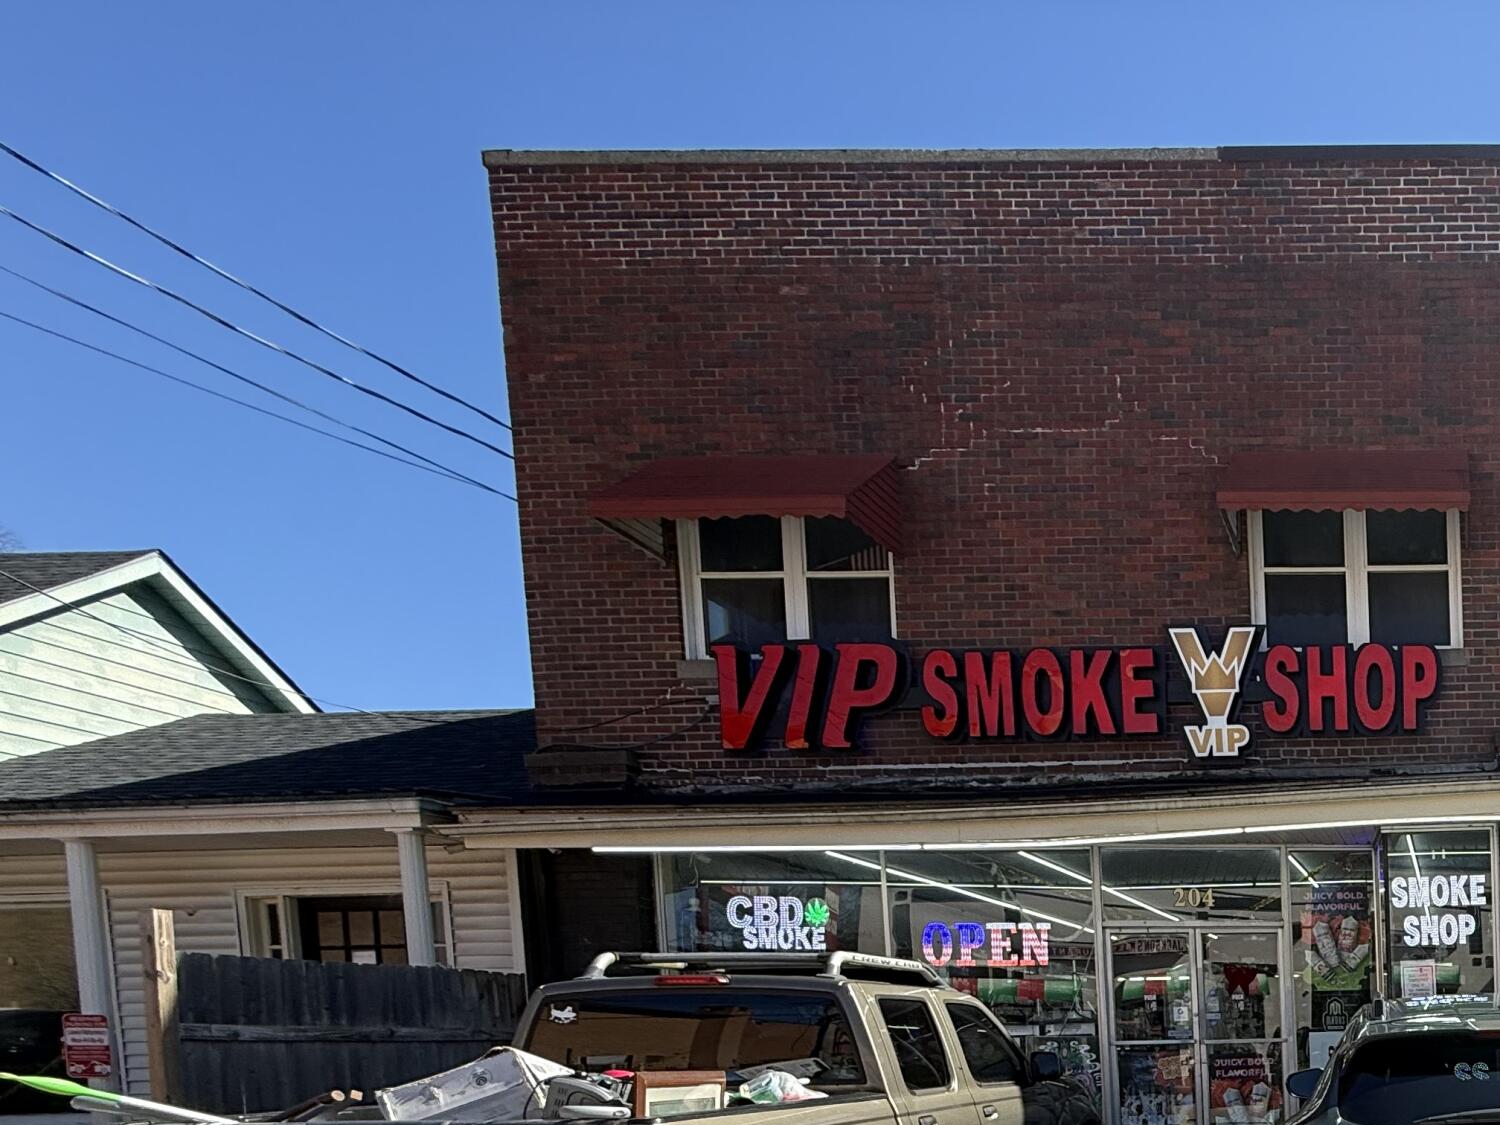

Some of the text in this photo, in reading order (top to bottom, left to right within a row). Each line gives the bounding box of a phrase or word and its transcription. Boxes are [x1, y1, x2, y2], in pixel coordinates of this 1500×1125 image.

[711, 642, 1159, 750] VIP SMOKE
[1263, 643, 1438, 732] SHOP
[1184, 724, 1250, 757] VIP
[1173, 888, 1216, 908] 204
[1336, 890, 1366, 900] BOLD.
[1391, 874, 1487, 908] SMOKE
[726, 895, 804, 929] CBD
[742, 926, 827, 951] SMOKE
[922, 921, 1051, 967] OPEN
[1403, 913, 1476, 947] SHOP
[852, 955, 891, 965] CREW
